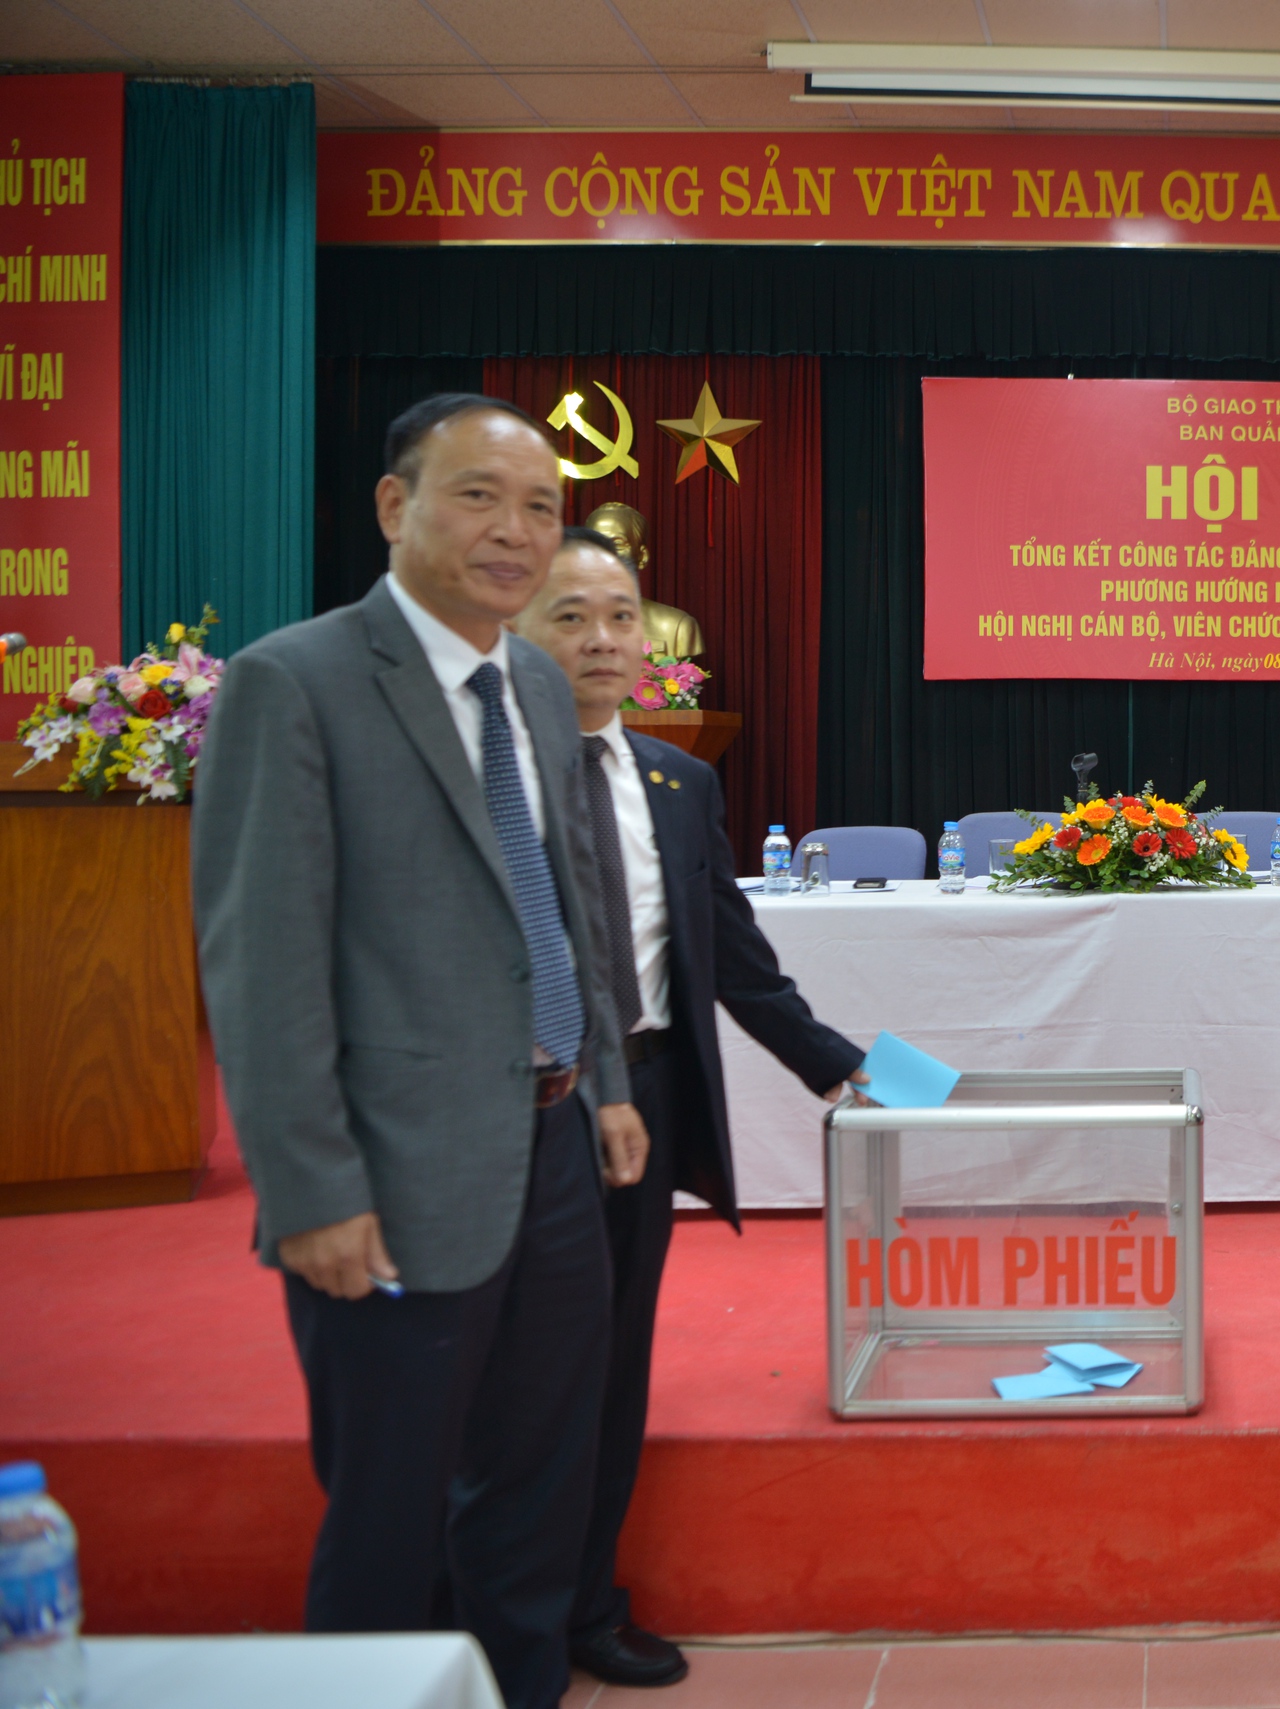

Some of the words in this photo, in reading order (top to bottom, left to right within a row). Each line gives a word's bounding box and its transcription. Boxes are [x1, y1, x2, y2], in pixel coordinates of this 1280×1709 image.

[31, 158, 86, 215] TỊCH
[368, 146, 528, 217] ĐẢNG
[545, 152, 704, 228] CỘNG
[720, 145, 835, 216] SẢN
[854, 154, 992, 228] VIỆT
[1012, 170, 1143, 218] NAM
[40, 254, 107, 301] MINH
[21, 353, 63, 410] ĐẠI
[1168, 394, 1198, 416] BỘ
[1204, 398, 1256, 414] GIAO
[1180, 425, 1223, 440] BAN
[41, 441, 89, 497] MÃI
[1146, 454, 1258, 532] HỘI
[1010, 536, 1066, 566] TỔNG
[1074, 538, 1112, 566] KẾT
[1120, 541, 1177, 567] CÔNG
[1185, 542, 1224, 567] TÁC
[1101, 578, 1188, 602] PHƯƠNG
[1196, 577, 1268, 602] HƯỚNG
[979, 611, 1013, 641] HỘI
[1022, 615, 1072, 640] NGHỊ
[1081, 611, 1124, 636] CÁN
[1132, 611, 1166, 641] BỘ,
[1174, 612, 1221, 636] VIÊN
[1149, 652, 1174, 667] Hà
[1180, 652, 1216, 672] Nội,
[845, 1216, 981, 1308] HÒM
[1003, 1210, 1177, 1306] PHIẾU
